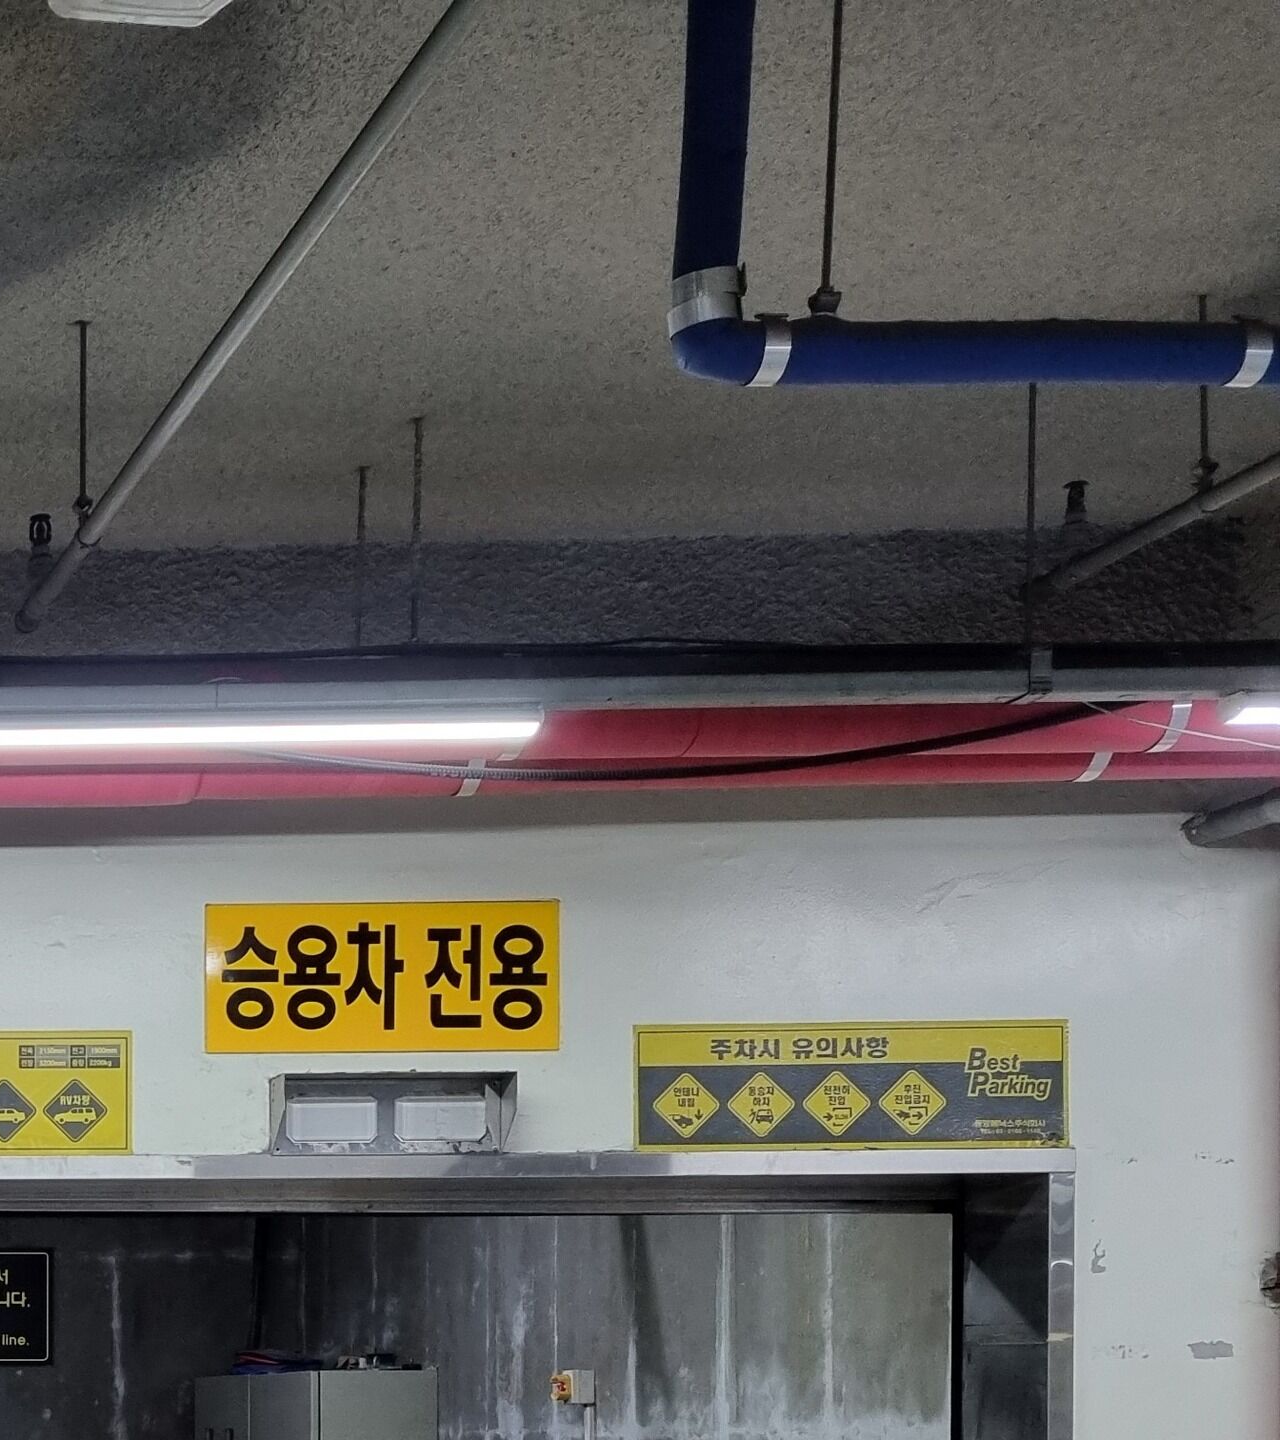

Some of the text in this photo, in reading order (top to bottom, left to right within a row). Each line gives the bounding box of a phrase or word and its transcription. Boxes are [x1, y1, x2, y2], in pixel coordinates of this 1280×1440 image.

[221, 922, 548, 1030] 승용차 전용
[710, 1037, 889, 1060] 주차시 유의사항
[967, 1048, 1019, 1071] Best
[904, 1085, 920, 1095] 후진
[970, 1072, 1050, 1098] Parking
[60, 1095, 90, 1106] RV차량
[828, 1096, 846, 1105] 진입
[895, 1095, 930, 1104] 진입금지
[2, 1333, 30, 1346] line.
